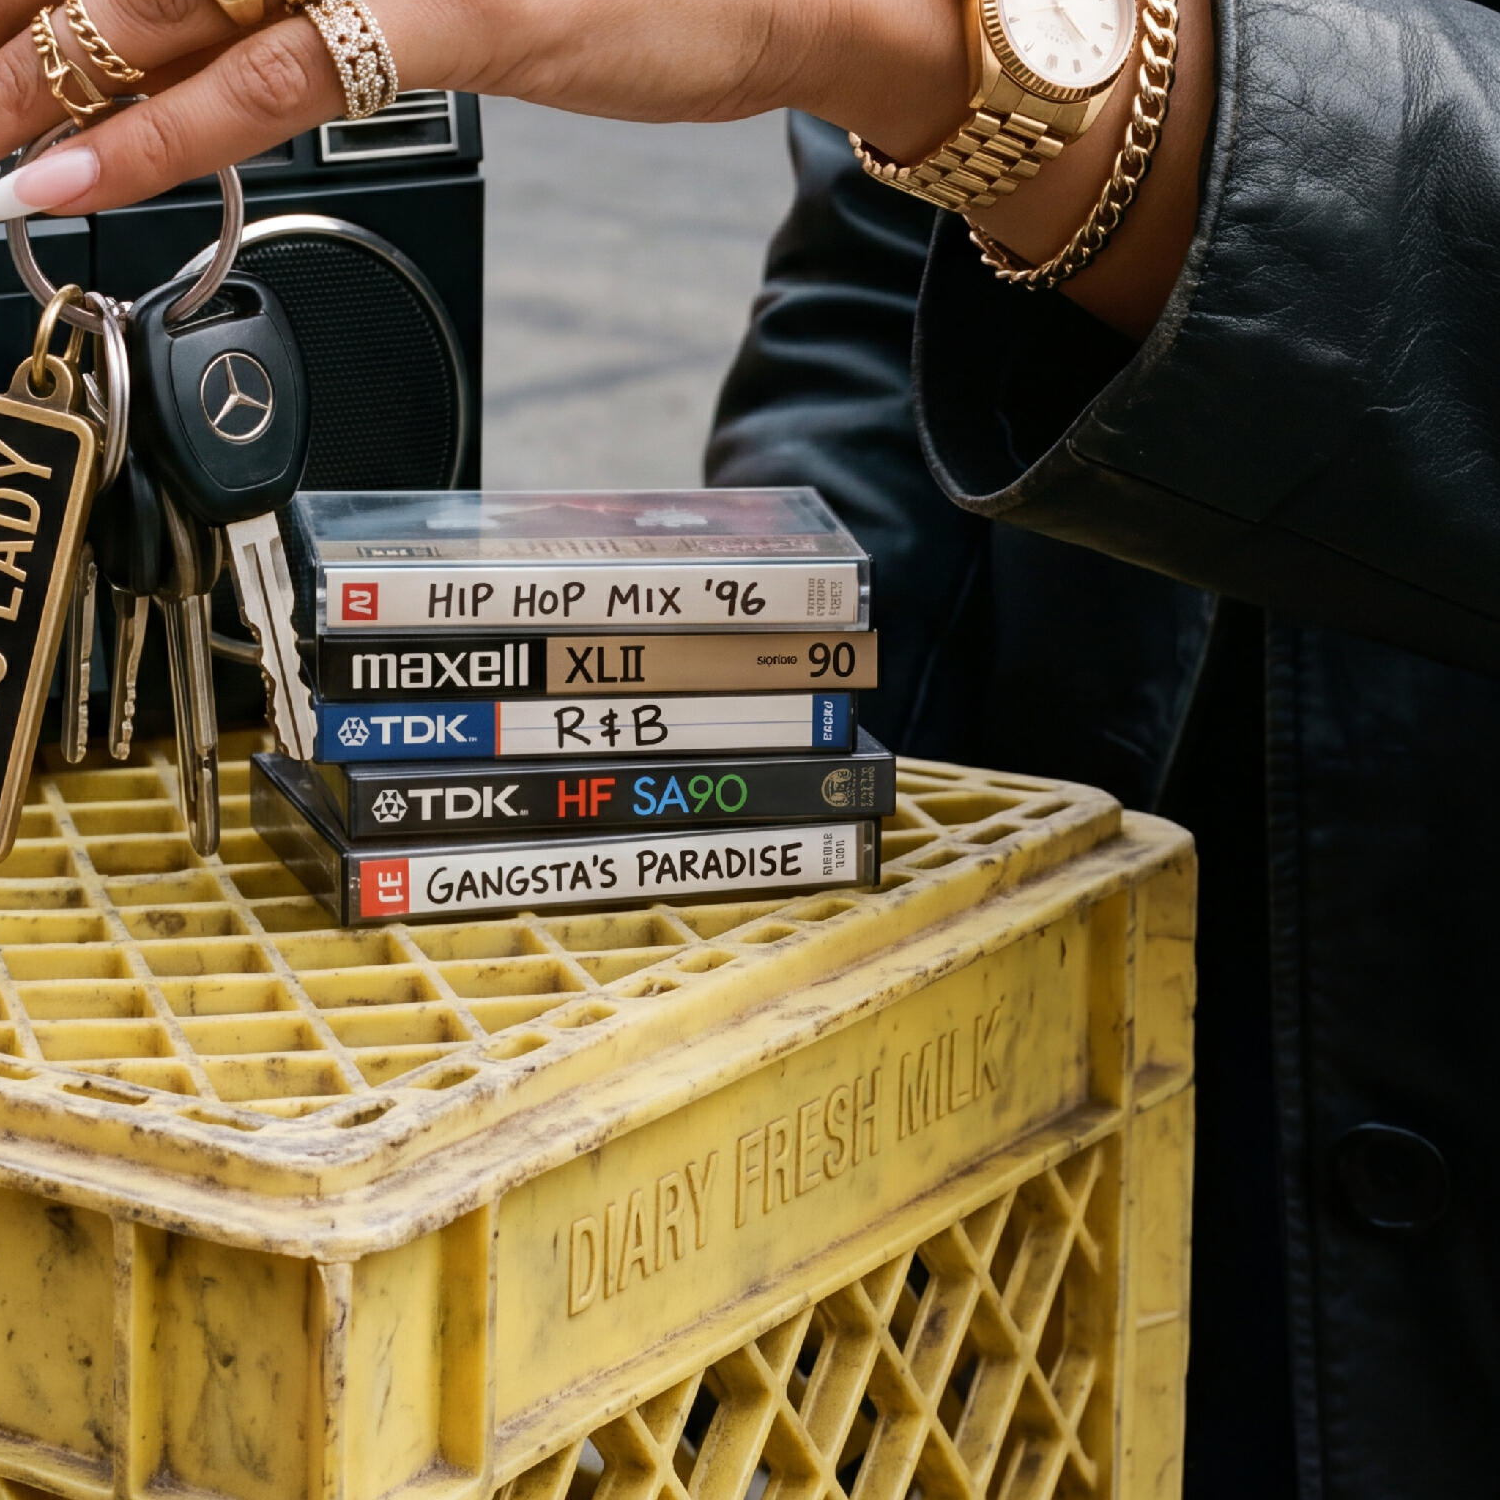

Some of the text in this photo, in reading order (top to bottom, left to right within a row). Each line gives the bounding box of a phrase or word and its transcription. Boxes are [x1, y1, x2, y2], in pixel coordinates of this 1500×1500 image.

[428, 582, 494, 619] HIP
[607, 583, 682, 618] MIX
[705, 578, 766, 617] '96
[352, 643, 646, 690] maxell XLII
[808, 642, 855, 678] 90
[370, 714, 470, 745] TDK
[408, 773, 748, 821] TDK HF SA90
[426, 853, 618, 905] GANGSTA'S
[636, 841, 803, 887] PARADISE
[567, 1005, 1002, 1318] DIARY FRESH MILK
